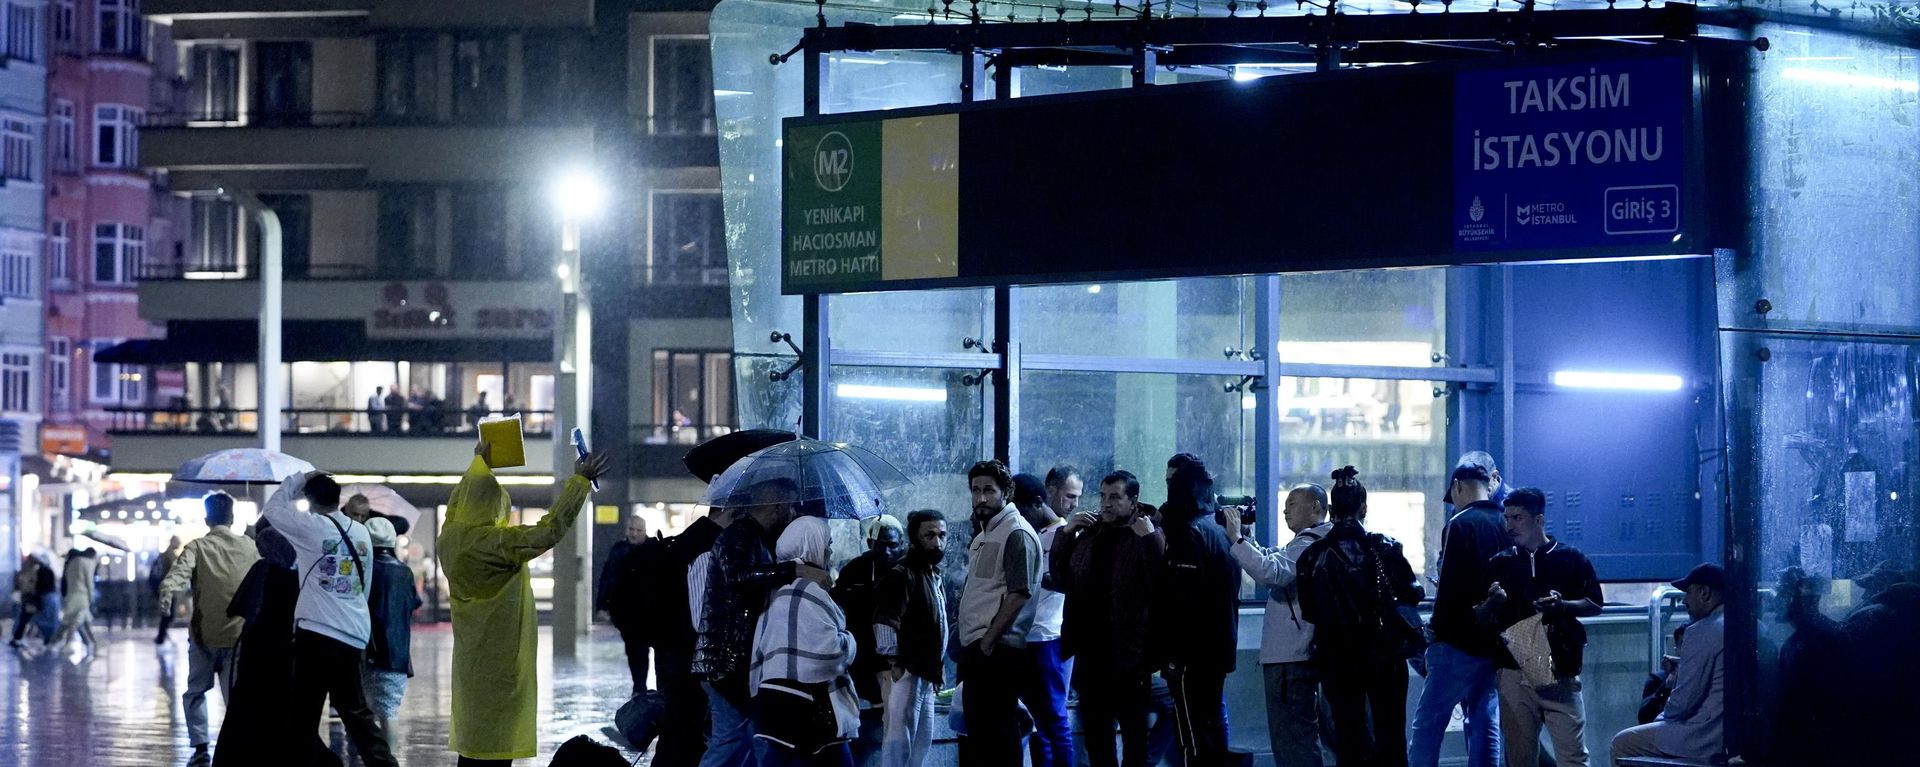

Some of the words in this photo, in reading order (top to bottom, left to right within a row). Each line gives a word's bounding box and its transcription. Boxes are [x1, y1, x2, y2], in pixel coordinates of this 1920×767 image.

[1504, 68, 1630, 114] TAKSİM
[1474, 126, 1663, 171] İSTASYONU
[819, 149, 848, 176] M2
[804, 204, 865, 225] YENİKAPI
[1531, 202, 1565, 213] METRO
[1611, 197, 1655, 223] GİRİŞ
[1661, 200, 1671, 218] 3
[1531, 214, 1577, 225] İSTANBUL
[793, 230, 876, 252] HACIOSMAN
[790, 257, 837, 277] METRO
[841, 255, 879, 274] HATTI
